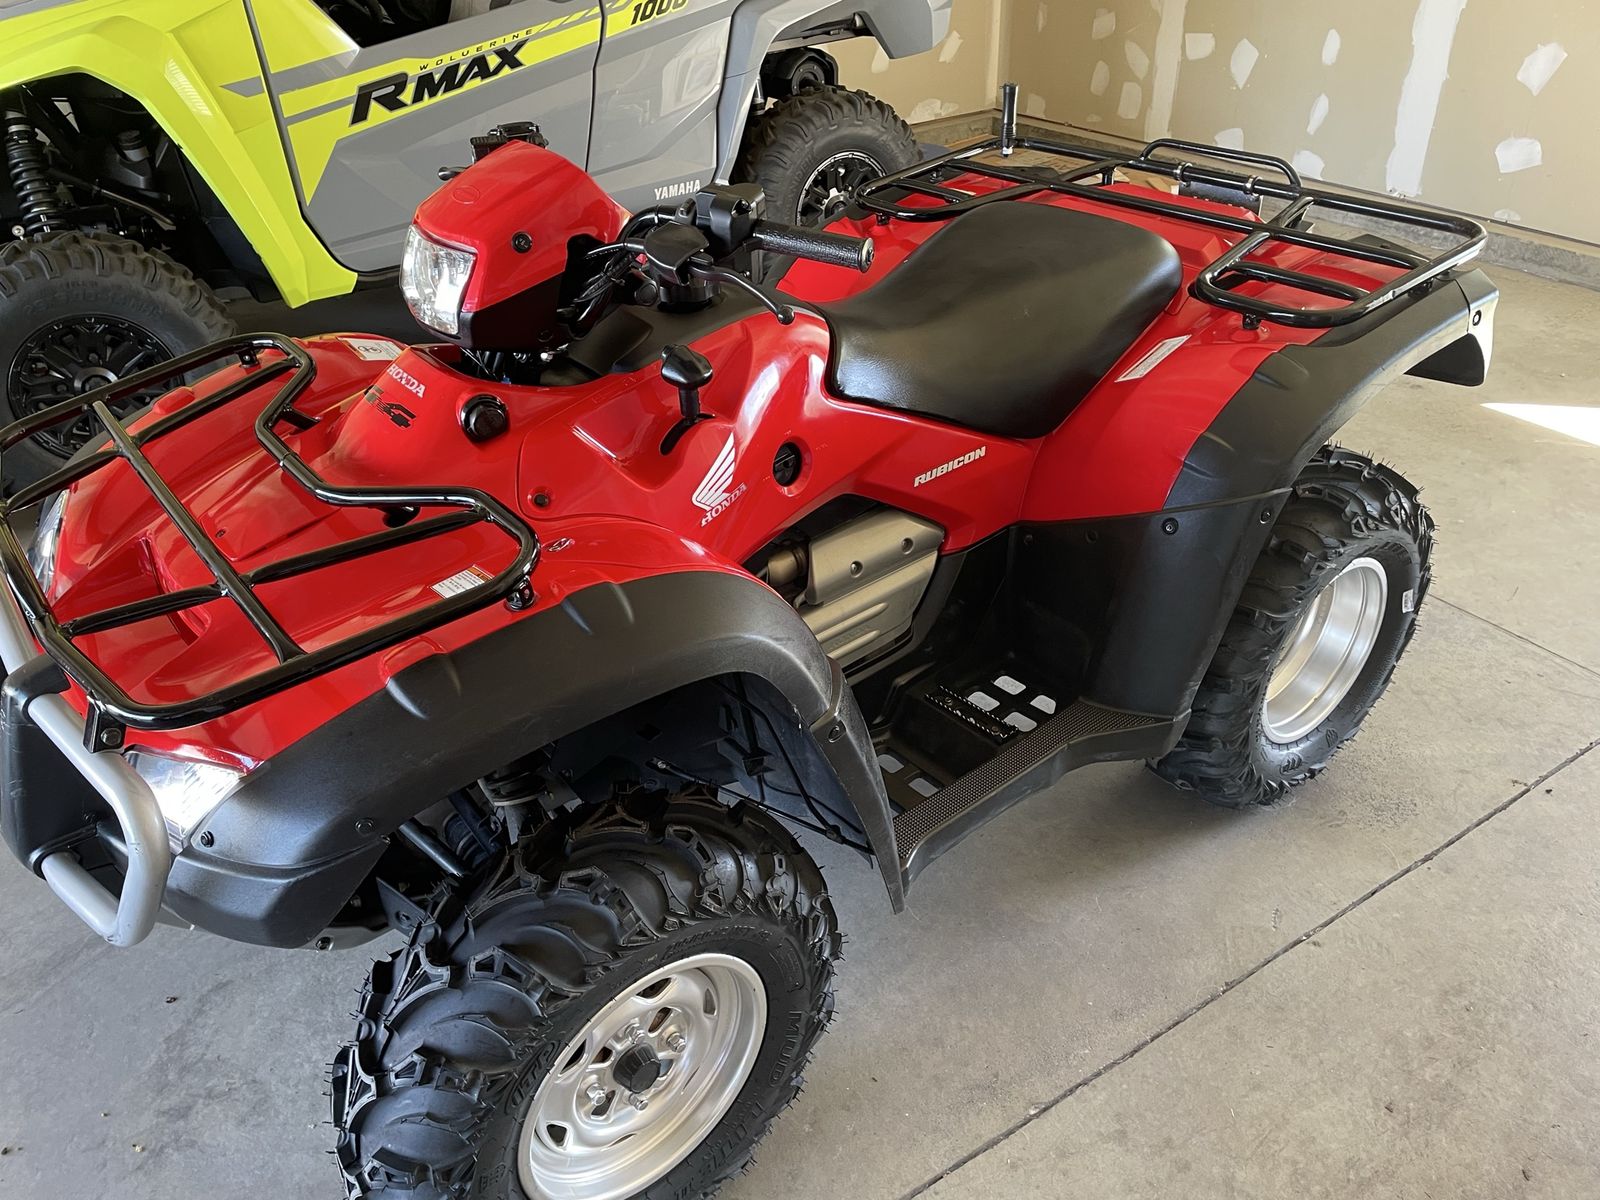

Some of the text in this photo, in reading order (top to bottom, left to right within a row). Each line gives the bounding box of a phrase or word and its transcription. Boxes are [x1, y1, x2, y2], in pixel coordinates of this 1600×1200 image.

[349, 39, 529, 127] RMAX
[654, 180, 701, 200] YAMAHA
[387, 363, 426, 398] HONDA
[914, 446, 986, 487] RUBICON
[701, 482, 748, 528] HONDA
